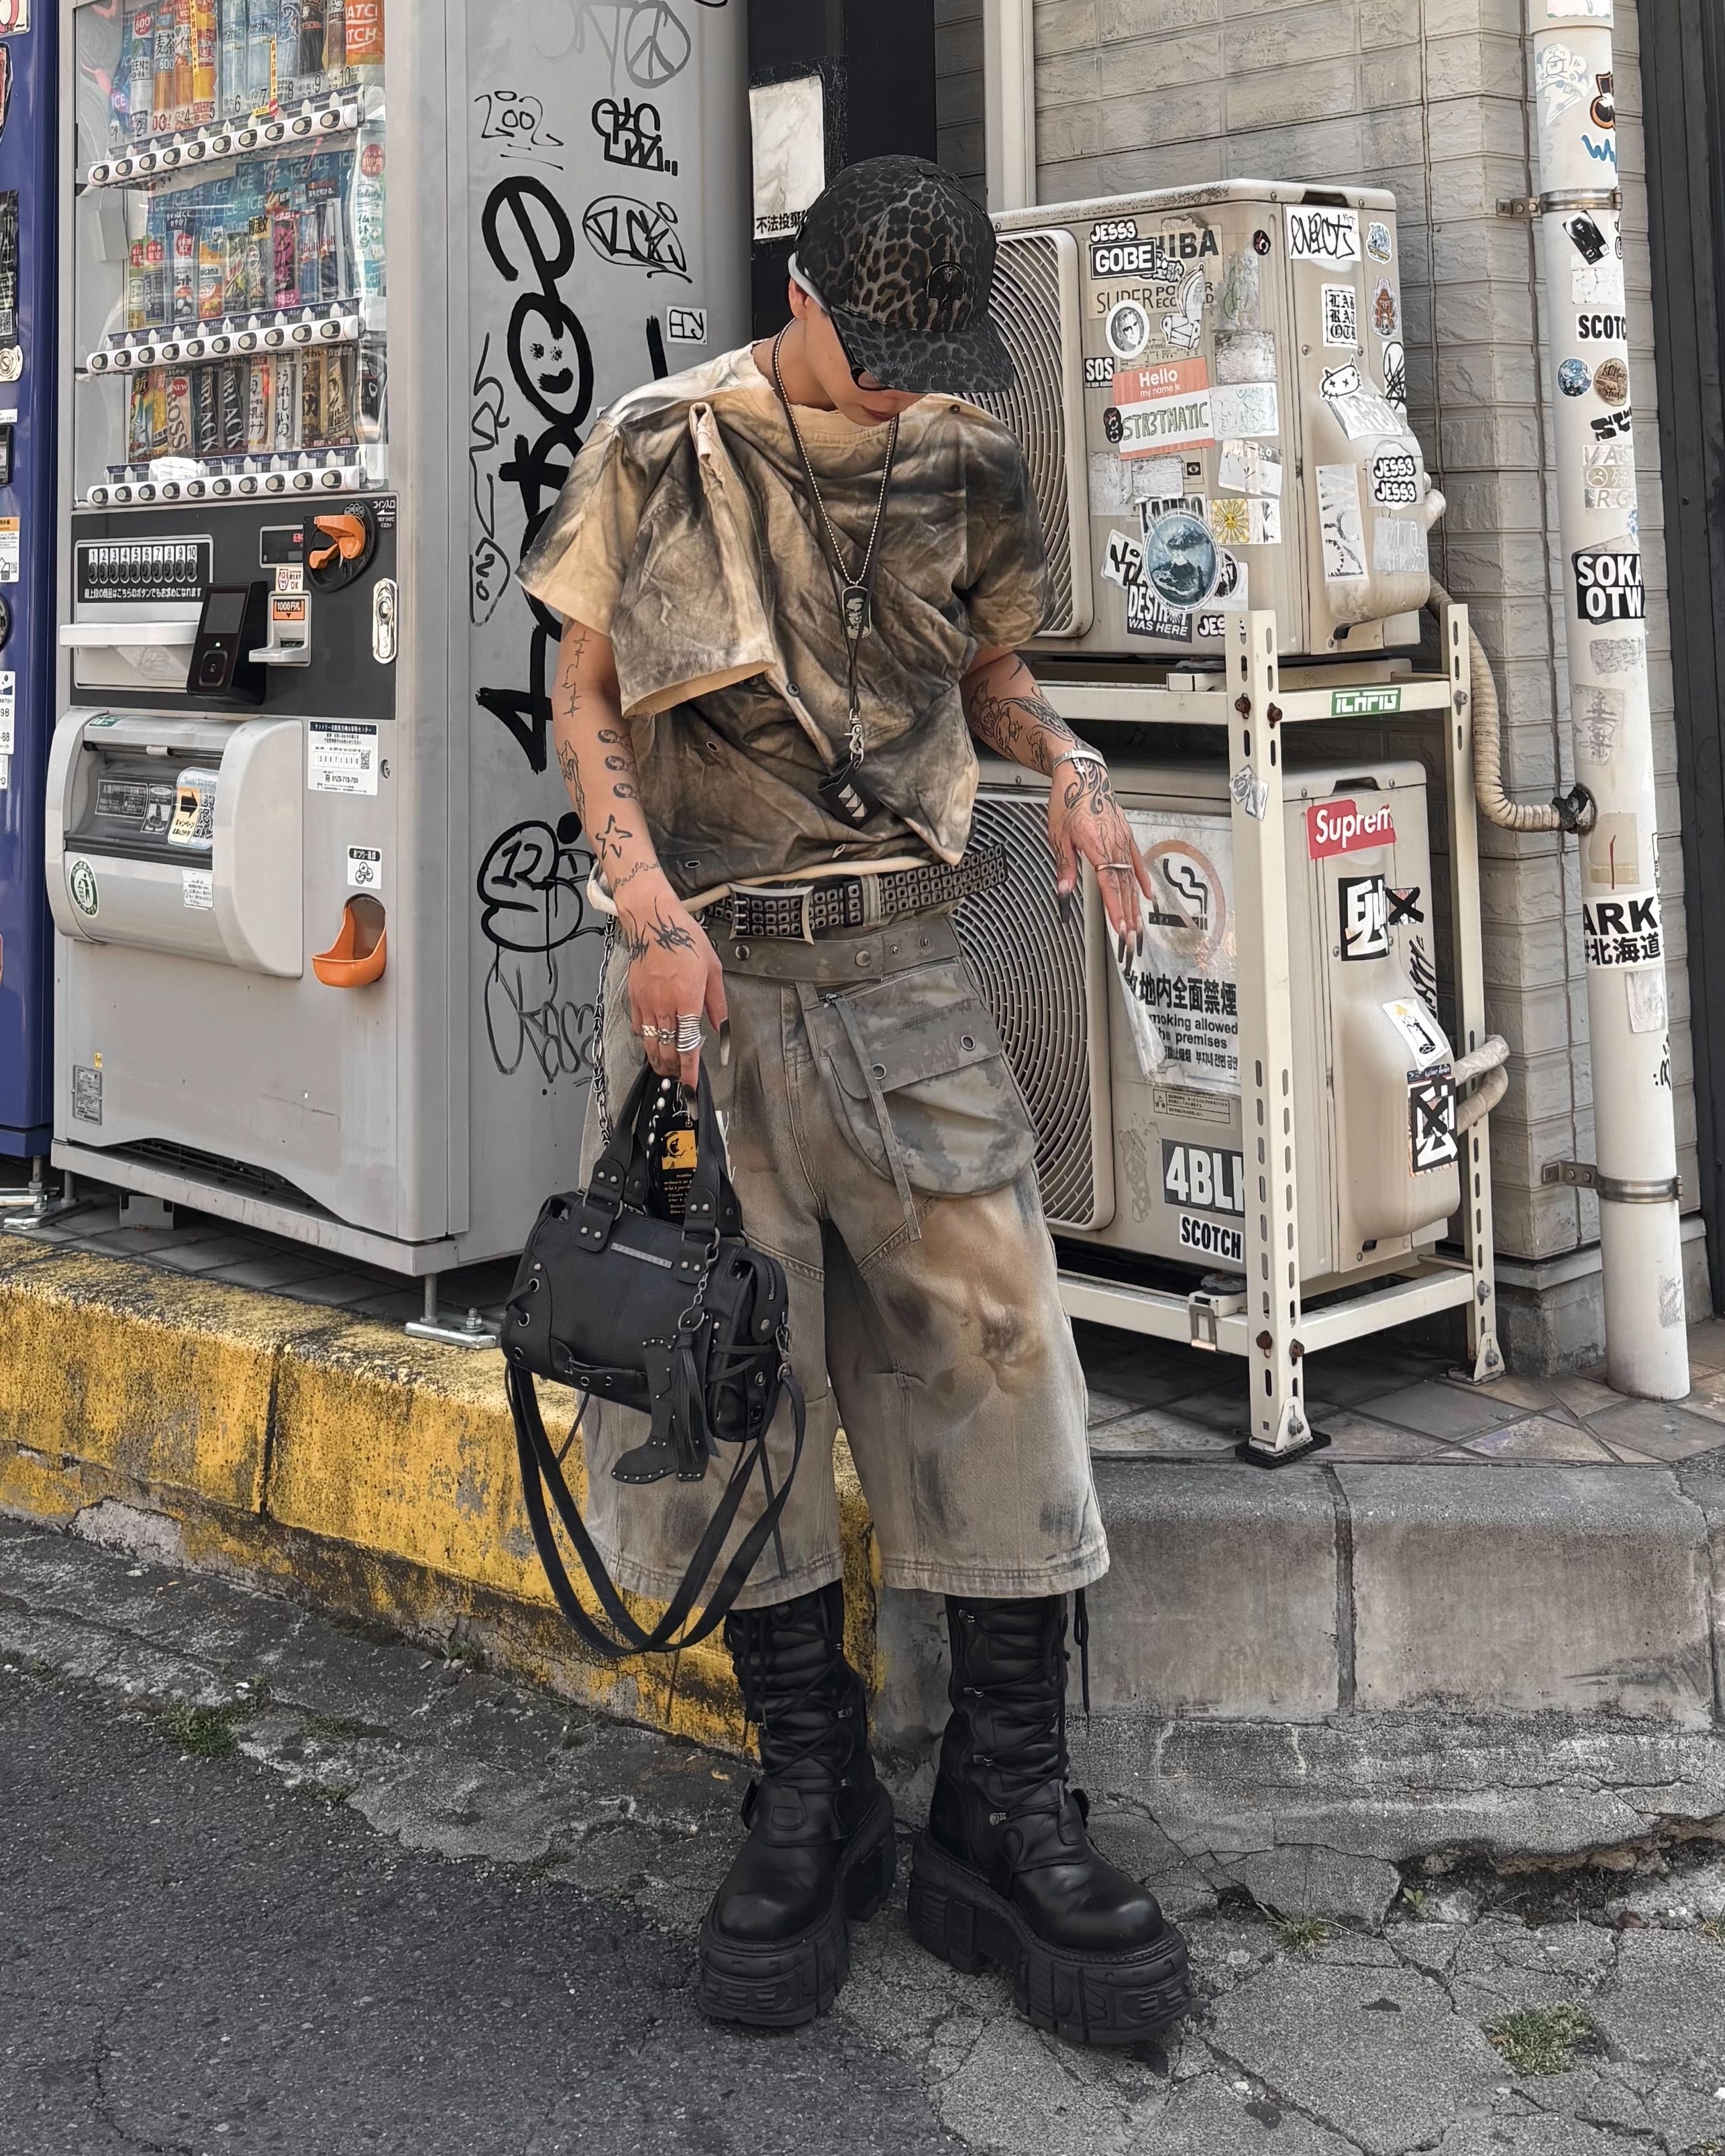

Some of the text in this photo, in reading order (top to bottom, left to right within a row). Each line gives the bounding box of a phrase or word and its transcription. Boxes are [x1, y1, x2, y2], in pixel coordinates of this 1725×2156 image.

[156, 34, 175, 57] 麦茶
[288, 82, 294, 99] 8
[315, 74, 321, 93] 9
[235, 95, 241, 113] 6
[259, 89, 267, 107] 7
[185, 108, 190, 121] 4
[1091, 220, 1137, 242] JESS3
[1096, 244, 1152, 273] GOBE
[1086, 358, 1113, 382] SOS
[1139, 368, 1178, 387] Hello
[1141, 388, 1150, 397] my
[223, 373, 244, 449] BLACK
[1375, 456, 1416, 478] JESS3
[1376, 480, 1417, 502] JESS3
[91, 550, 95, 561] 1
[102, 549, 106, 561] 2
[113, 549, 117, 560] 3
[123, 549, 127, 559] 4
[134, 549, 138, 559] 5
[145, 548, 150, 559] 6
[156, 547, 160, 559] 7
[167, 547, 171, 559] 8
[178, 547, 182, 559] 9
[189, 546, 196, 558] 10
[1129, 618, 1188, 636] WAS HERE
[1198, 616, 1225, 636] JES
[1585, 932, 1661, 966] 北海道
[1149, 1014, 1238, 1034] moking allowed
[1159, 1028, 1227, 1048] he premises
[1182, 1216, 1241, 1259] SCOTCH
